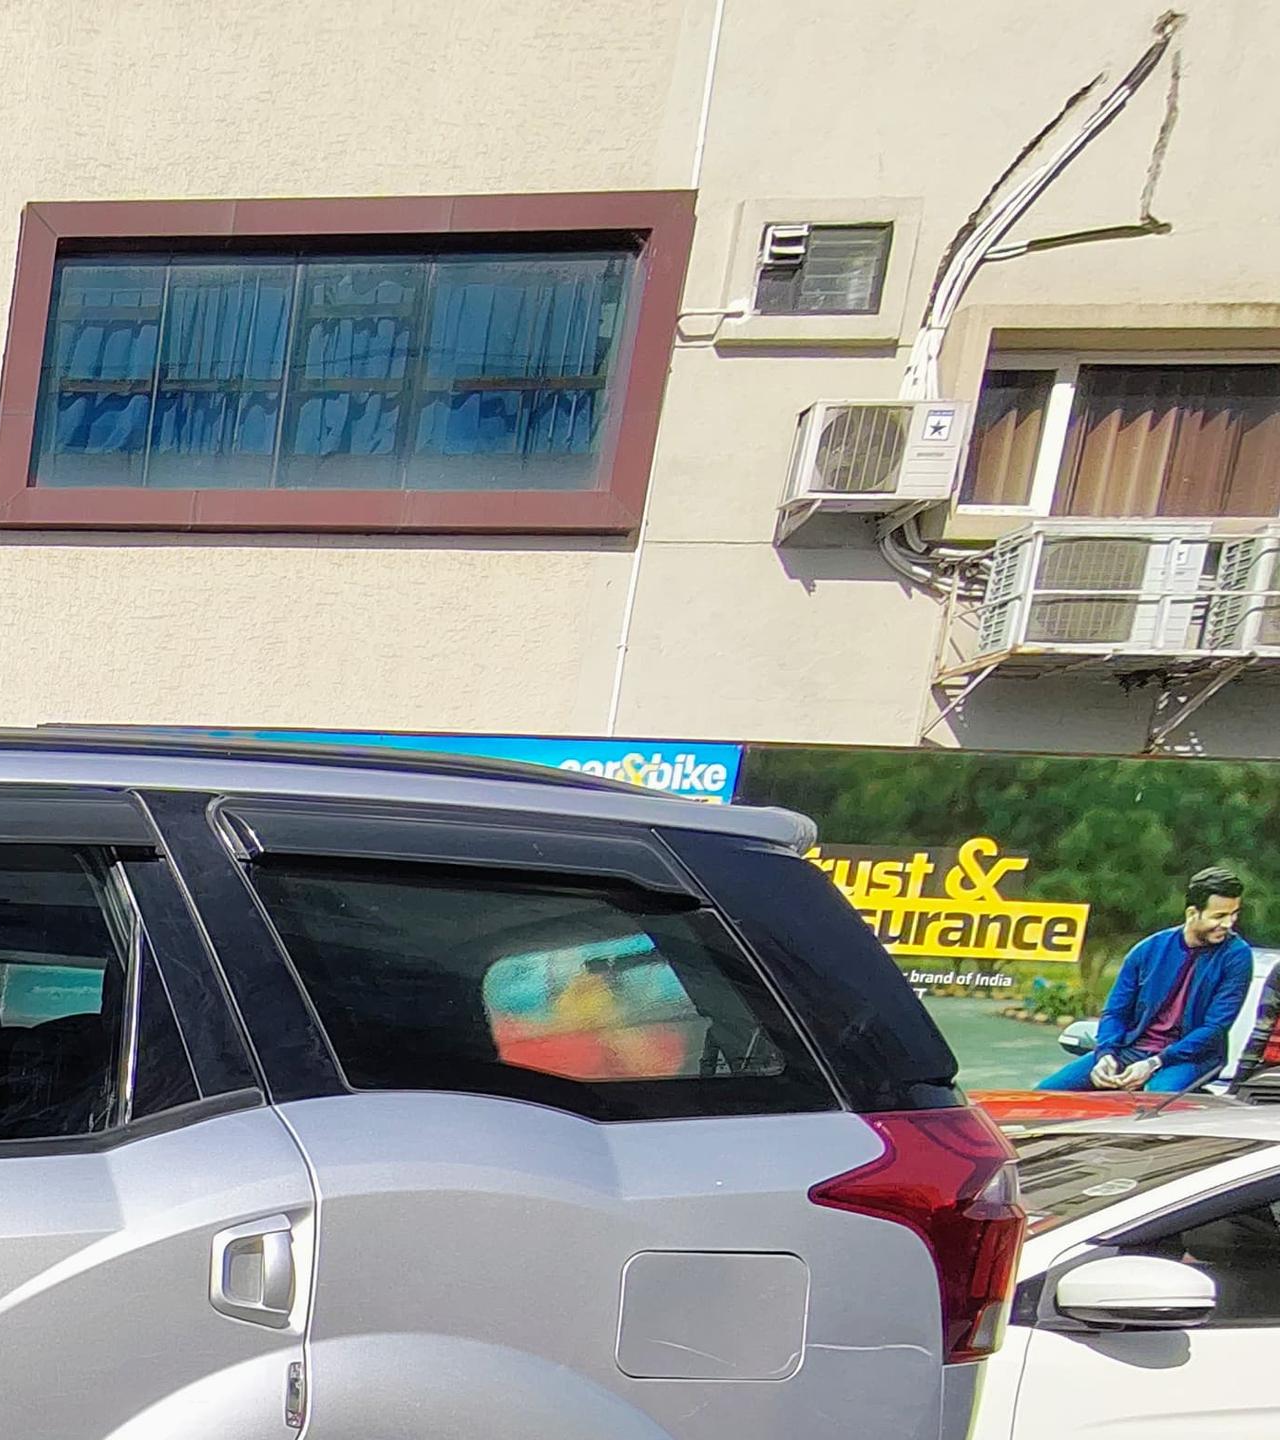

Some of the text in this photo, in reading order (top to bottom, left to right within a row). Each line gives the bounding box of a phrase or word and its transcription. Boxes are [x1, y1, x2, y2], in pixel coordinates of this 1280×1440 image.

[801, 837, 1028, 902] ust &
[909, 969, 1013, 987] brand of India
